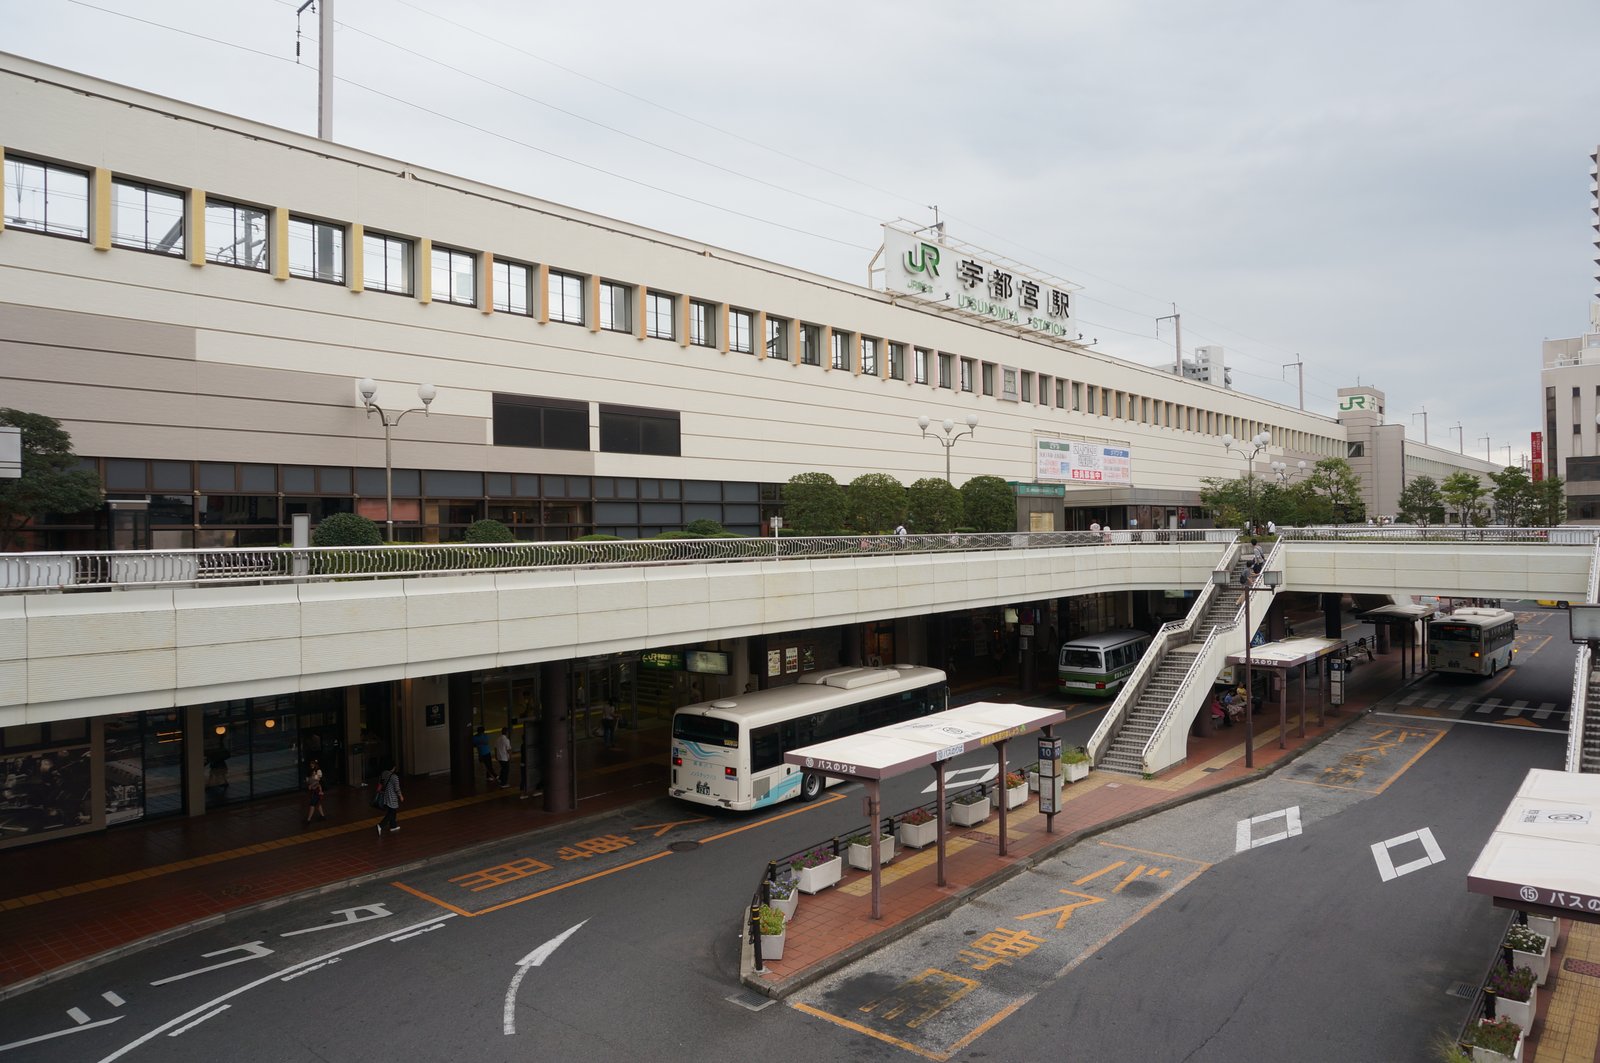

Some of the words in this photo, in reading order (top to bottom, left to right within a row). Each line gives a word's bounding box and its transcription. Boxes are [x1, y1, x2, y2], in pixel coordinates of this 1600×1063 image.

[904, 242, 940, 278] JR
[957, 259, 1070, 319] 宇都宮駅
[1339, 396, 1365, 411] JR
[1042, 748, 1051, 757] 10
[817, 760, 857, 774] バスのりば
